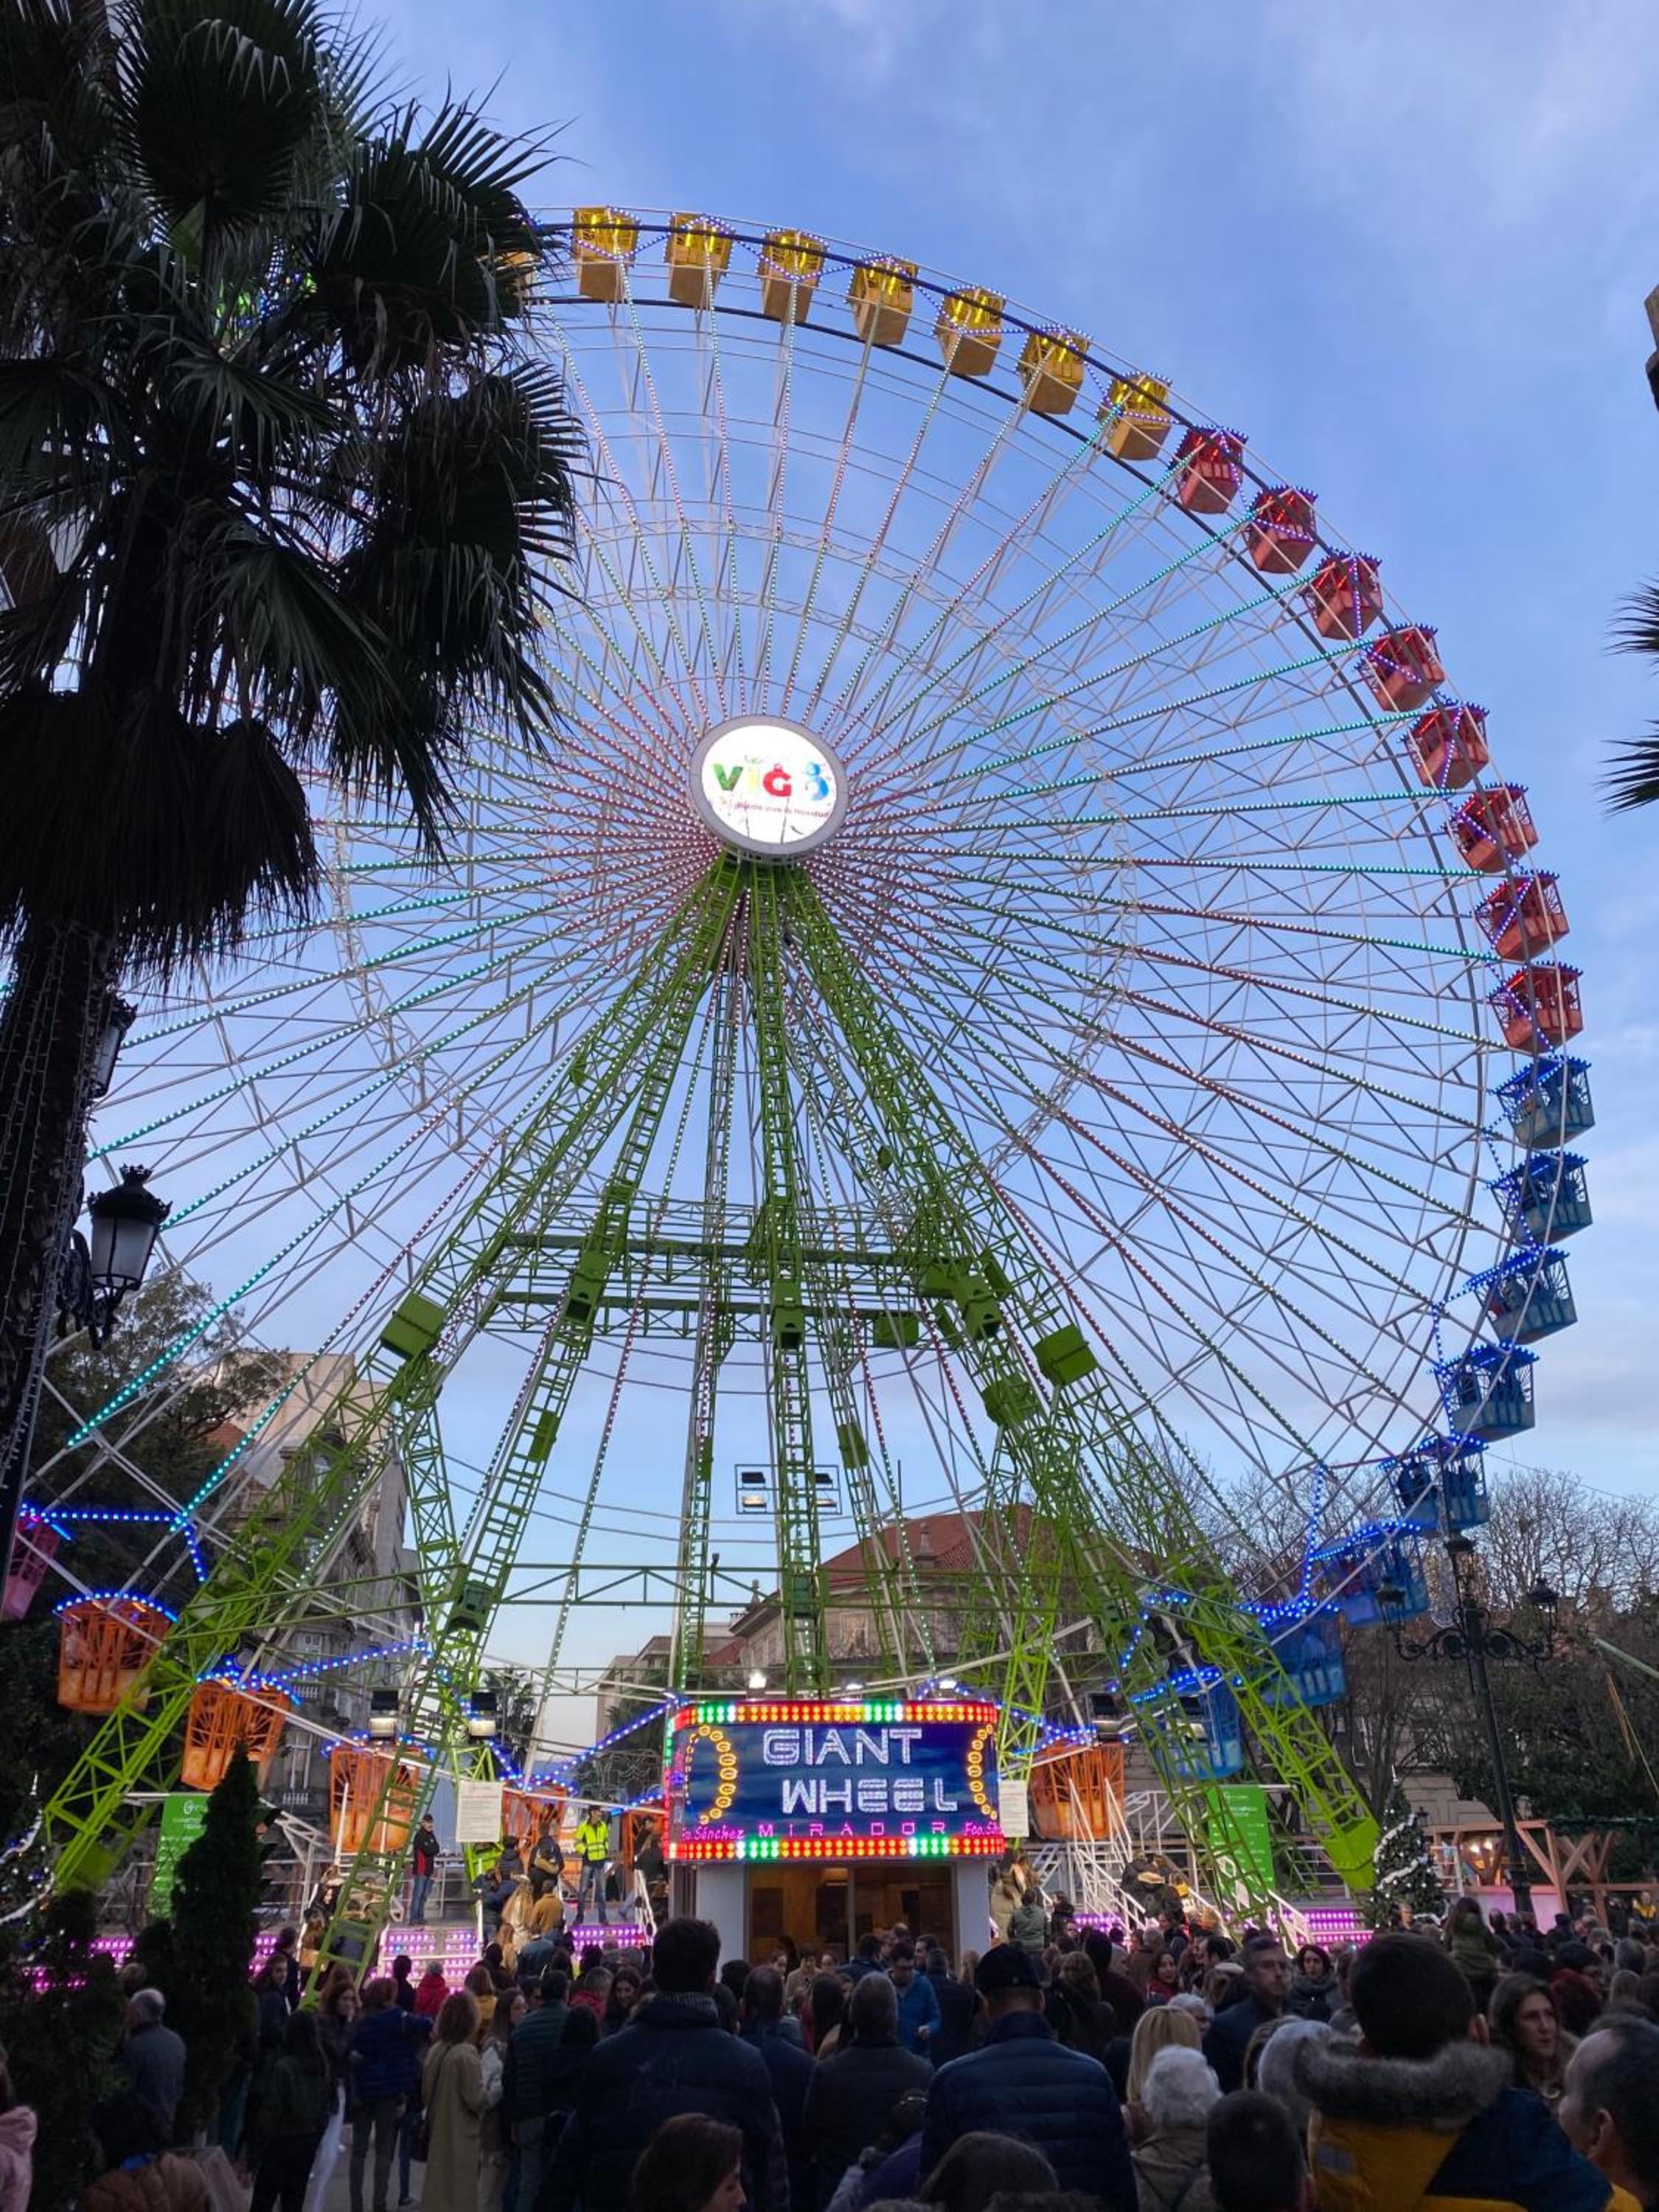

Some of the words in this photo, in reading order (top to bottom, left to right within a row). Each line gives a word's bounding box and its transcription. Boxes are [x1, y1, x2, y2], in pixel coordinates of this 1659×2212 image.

[763, 1728, 922, 1765] GIANT
[782, 1778, 958, 1814] WHEEL
[758, 1822, 945, 1838] MIRADOR
